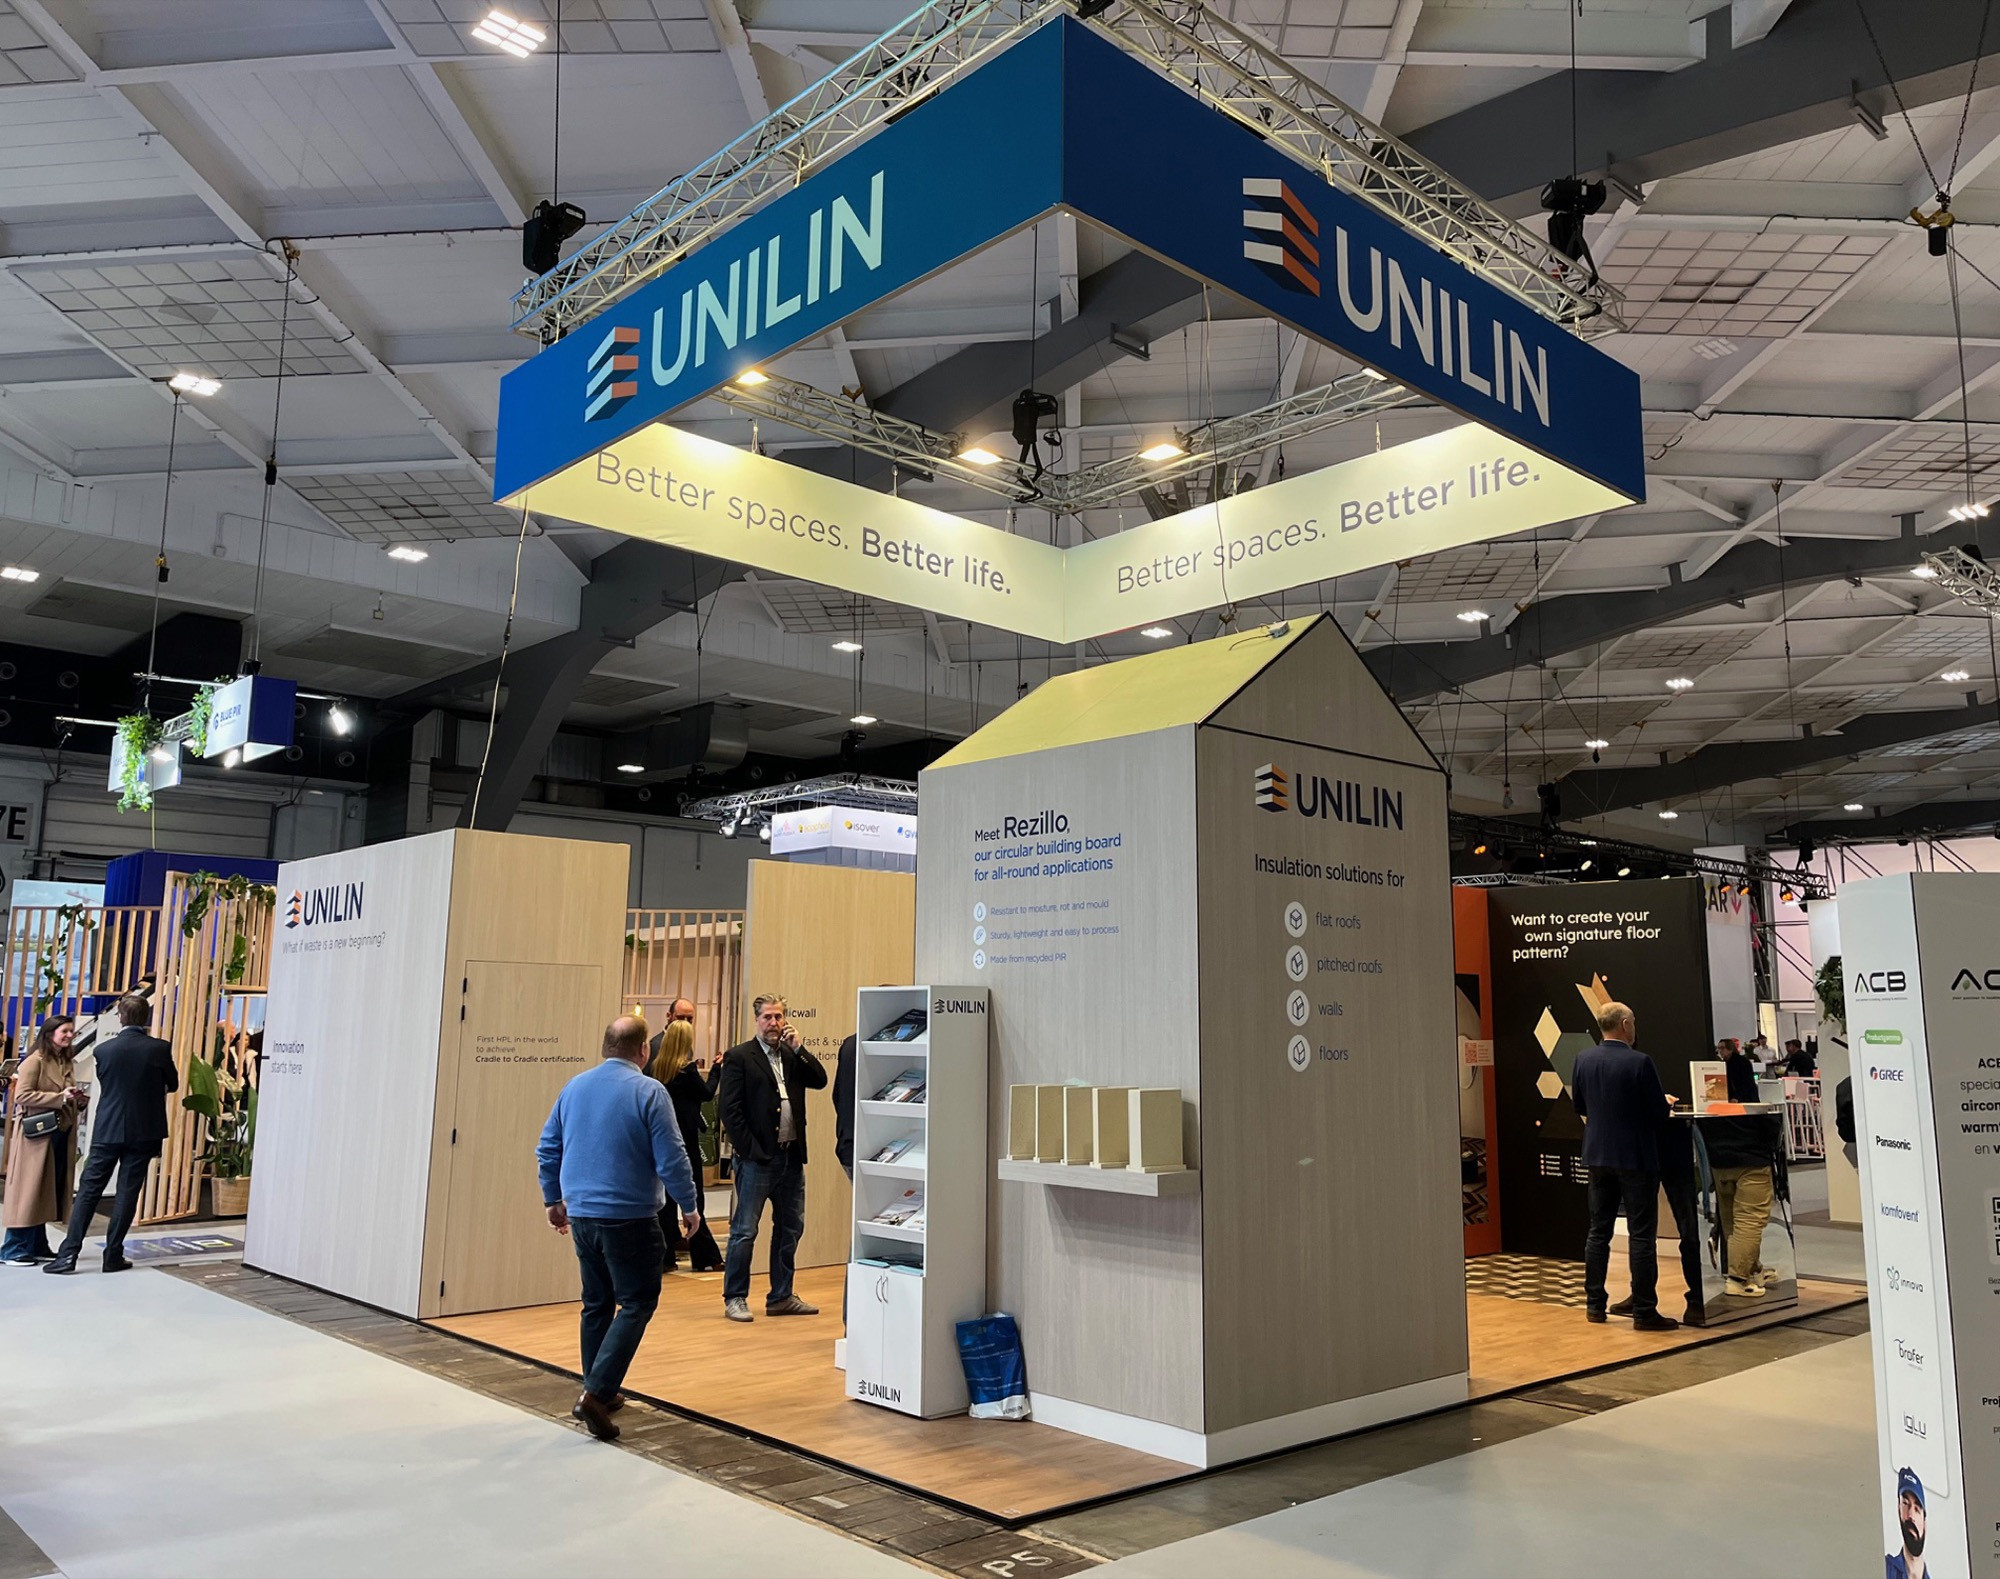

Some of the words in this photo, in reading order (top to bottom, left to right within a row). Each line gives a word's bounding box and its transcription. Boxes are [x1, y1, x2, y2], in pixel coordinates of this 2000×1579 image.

[652, 170, 884, 386] UNILIN
[1336, 225, 1550, 428] UNILIN
[596, 451, 715, 511] Better
[727, 495, 849, 551] spaces.
[862, 526, 954, 578] Better
[964, 555, 1012, 595] life.
[1117, 550, 1202, 594] Better
[1213, 518, 1326, 573] spaces.
[1340, 476, 1455, 534] Better
[1468, 457, 1541, 498] life.
[1296, 773, 1403, 831] UNILIN
[853, 823, 880, 833] isover
[974, 828, 1000, 842] Meet
[1004, 809, 1070, 839] Rezillo,
[974, 851, 991, 862] our
[994, 844, 1034, 860] circular
[1036, 838, 1082, 856] building
[1085, 833, 1121, 850] board
[974, 868, 989, 881] for
[992, 863, 1040, 880] all-round
[1042, 857, 1113, 877] applications
[1254, 853, 1322, 879] Insulation
[1325, 863, 1384, 885] solutions
[1387, 869, 1405, 888] for
[303, 881, 364, 926] UNILIN
[990, 906, 1019, 915] Resistant
[1020, 905, 1027, 914] to
[1059, 903, 1070, 911] rot
[1071, 901, 1085, 910] and
[1086, 899, 1109, 909] mould
[1315, 912, 1333, 927] flat
[1335, 915, 1361, 929] roofs
[1511, 913, 1547, 926] Want
[1549, 913, 1564, 925] to
[1567, 911, 1613, 924] create
[1616, 911, 1650, 926] your
[1013, 929, 1048, 940] lightweight
[1050, 929, 1063, 937] and
[1064, 928, 1081, 938] easy
[1082, 927, 1090, 935] to
[1091, 925, 1119, 935] process
[1524, 931, 1553, 943] own
[1556, 926, 1623, 944] signature
[1626, 926, 1662, 939] floor
[304, 940, 321, 952] waste
[334, 939, 347, 949] new
[349, 931, 386, 949] beginning?
[990, 956, 1007, 964] Made
[1009, 955, 1024, 963] from
[1025, 953, 1053, 963] recycled
[1055, 952, 1067, 961] PIR
[1512, 945, 1569, 962] pattern?
[1317, 957, 1355, 974] pitched
[1357, 959, 1383, 974] roofs
[1854, 971, 1906, 993] ACB
[783, 1008, 817, 1018] licwall
[946, 1000, 985, 1014] UNILIN
[1318, 1002, 1343, 1016] walls
[272, 1040, 304, 1054] Innovation
[477, 1036, 494, 1044] First
[537, 1036, 559, 1044] world
[802, 1036, 820, 1046] fast
[822, 1036, 829, 1046] &
[486, 1045, 516, 1053] achieve
[1319, 1046, 1349, 1060] floors
[475, 1055, 501, 1063] Cradle
[503, 1055, 511, 1063] to
[513, 1055, 538, 1063] Cradle
[540, 1055, 586, 1063] certification.
[1879, 1069, 1904, 1081] GREE
[1875, 1135, 1912, 1151] Panasonic
[1974, 1144, 1990, 1155] en
[1881, 1203, 1919, 1223] komfovent
[1900, 1278, 1924, 1293] innova
[867, 1382, 901, 1403] UNILIN
